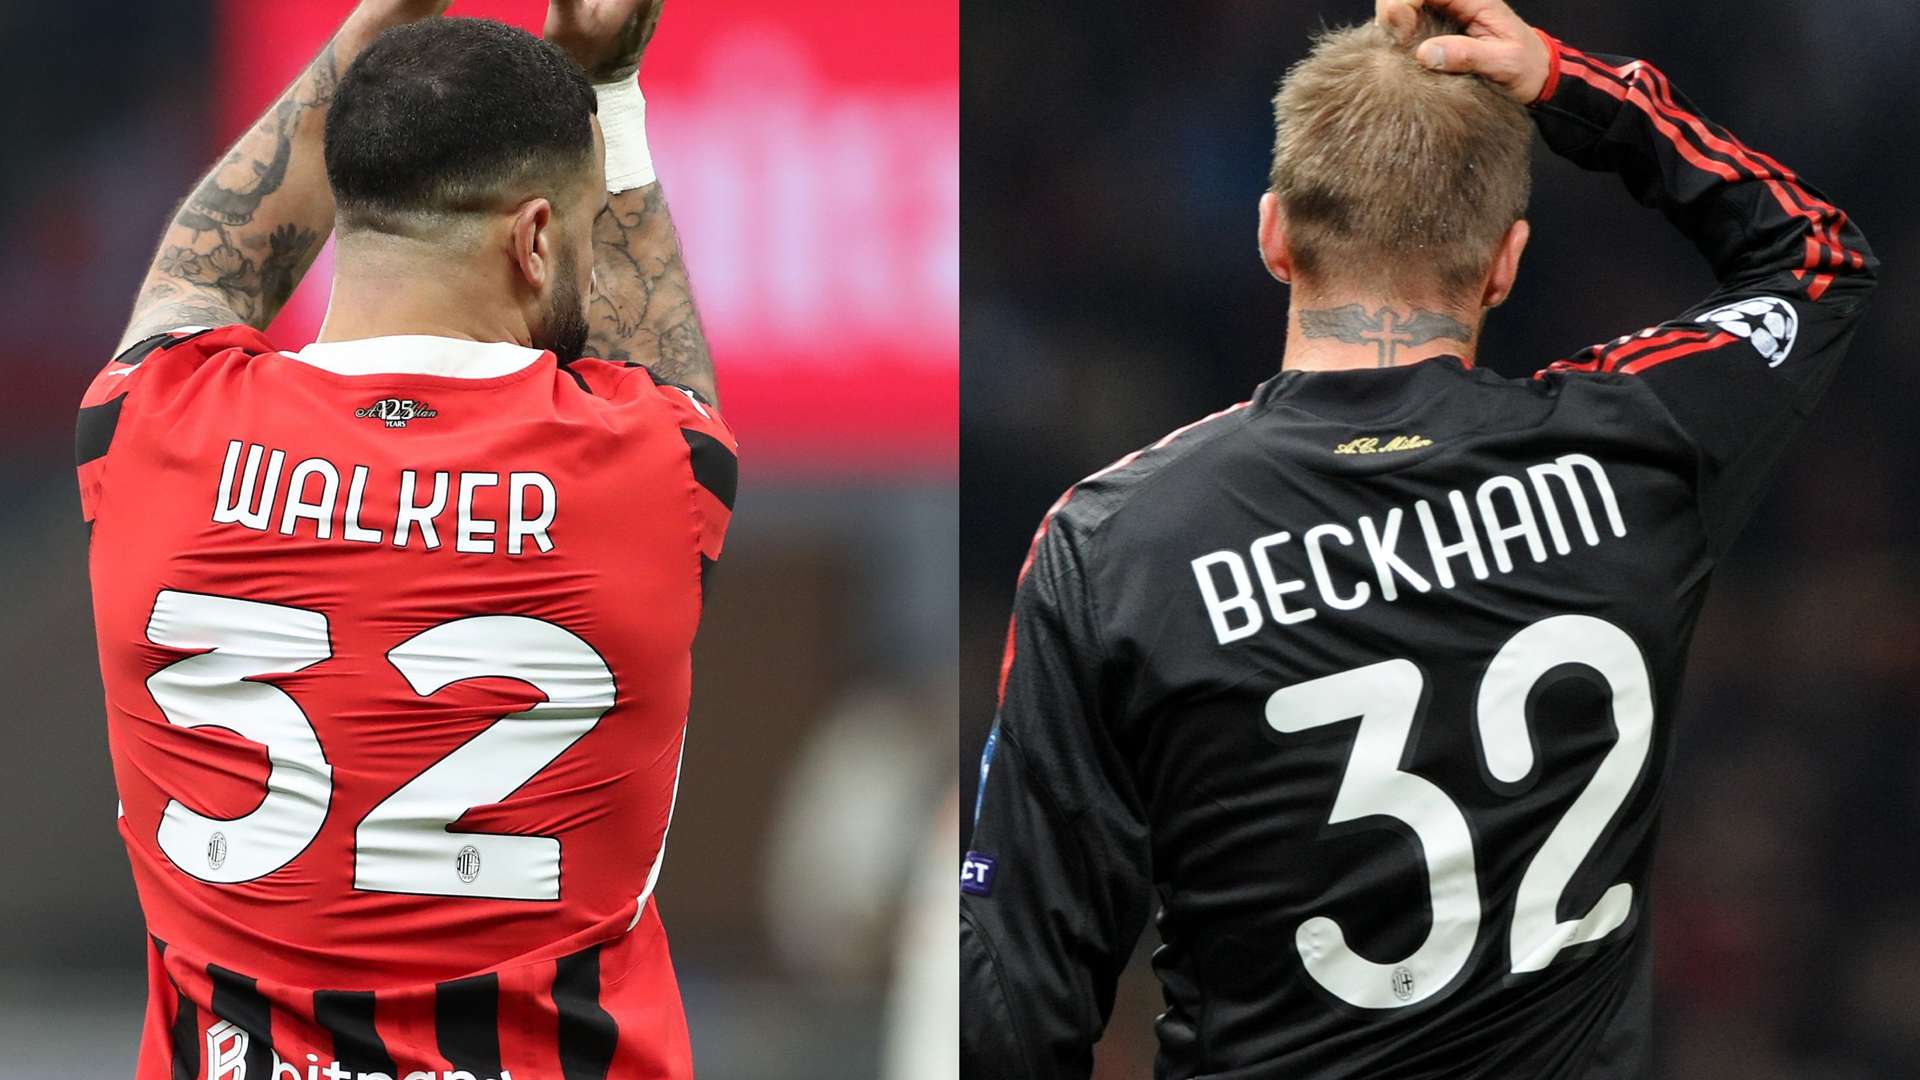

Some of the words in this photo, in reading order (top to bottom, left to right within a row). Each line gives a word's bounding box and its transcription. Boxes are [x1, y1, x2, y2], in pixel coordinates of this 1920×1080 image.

[379, 399, 415, 420] 125
[386, 420, 406, 428] YEARS
[213, 439, 557, 555] WALKER
[1191, 453, 1626, 646] BECKHAM
[145, 589, 618, 902] 32
[1264, 613, 1655, 1010] 32
